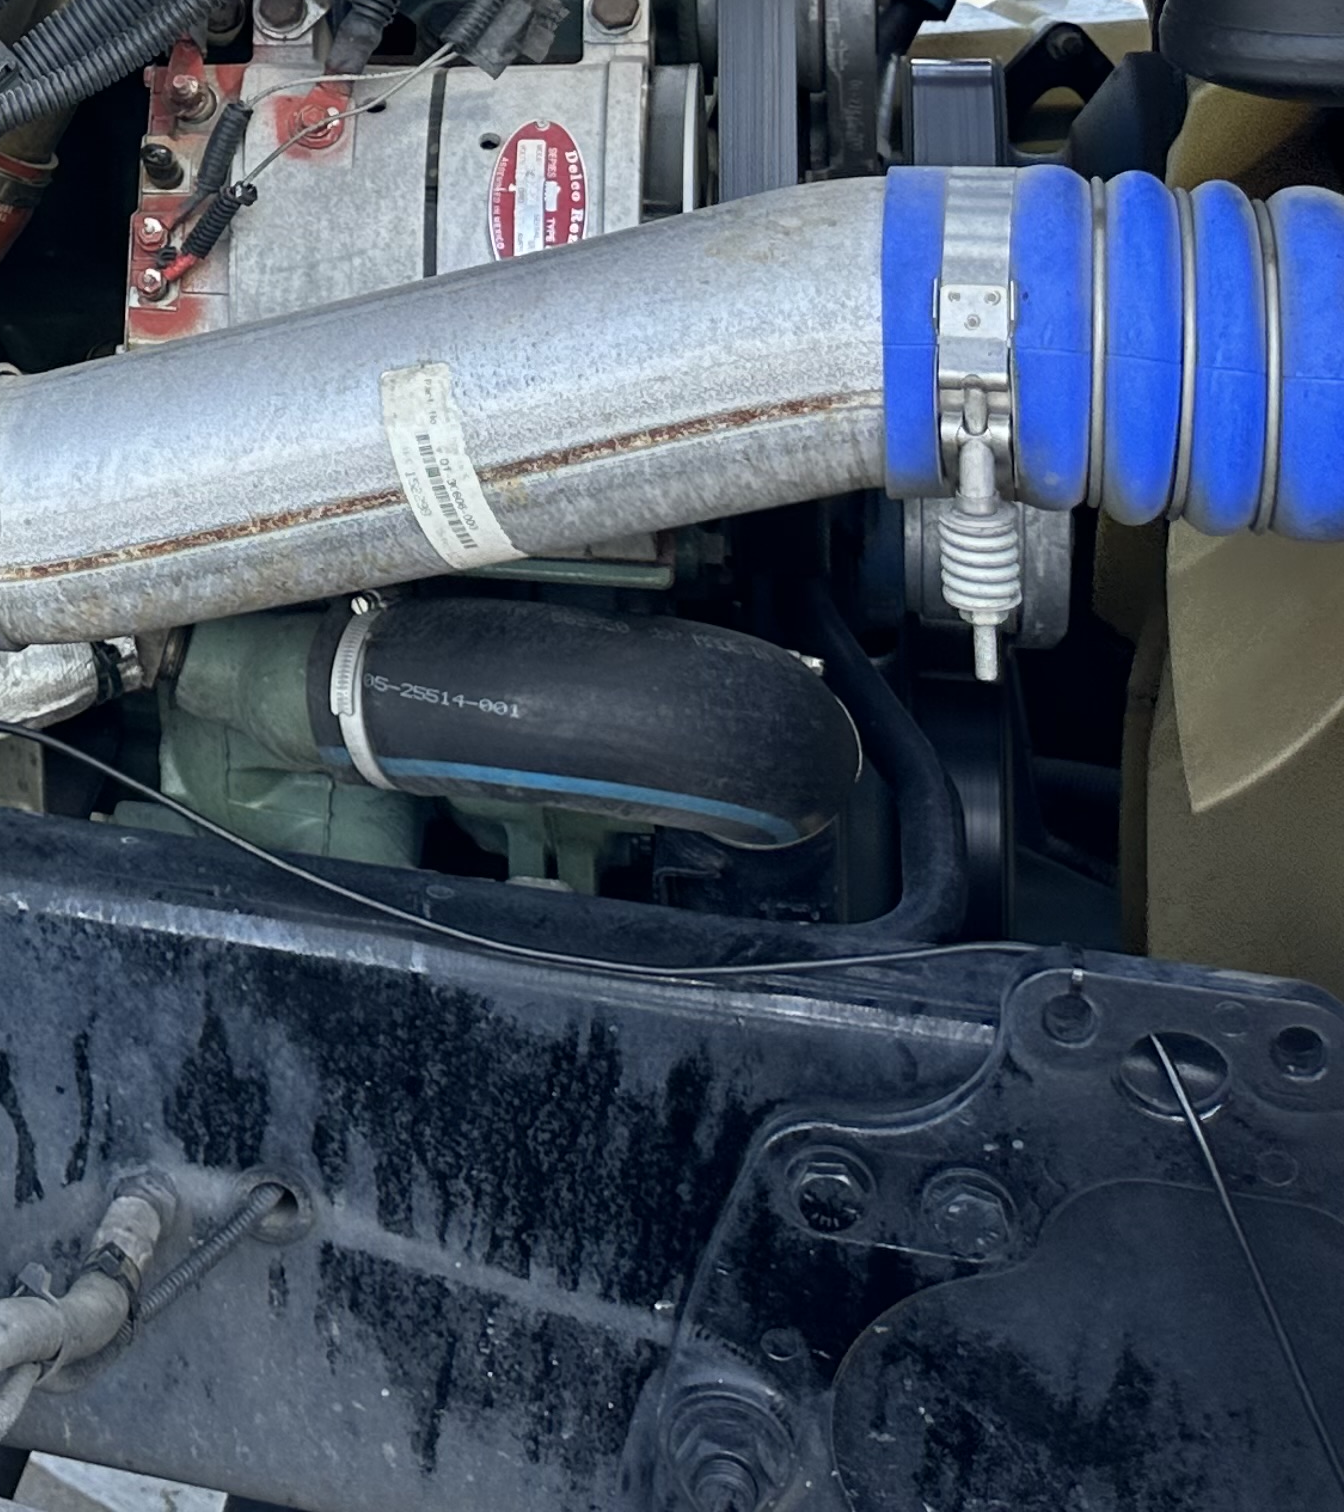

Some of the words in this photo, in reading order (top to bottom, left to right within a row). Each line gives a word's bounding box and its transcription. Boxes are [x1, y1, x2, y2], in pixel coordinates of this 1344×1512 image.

[546, 147, 558, 178] SERIES
[564, 150, 583, 202] Delco
[546, 216, 556, 243] TYPE
[362, 672, 523, 720] 05-25514-001
